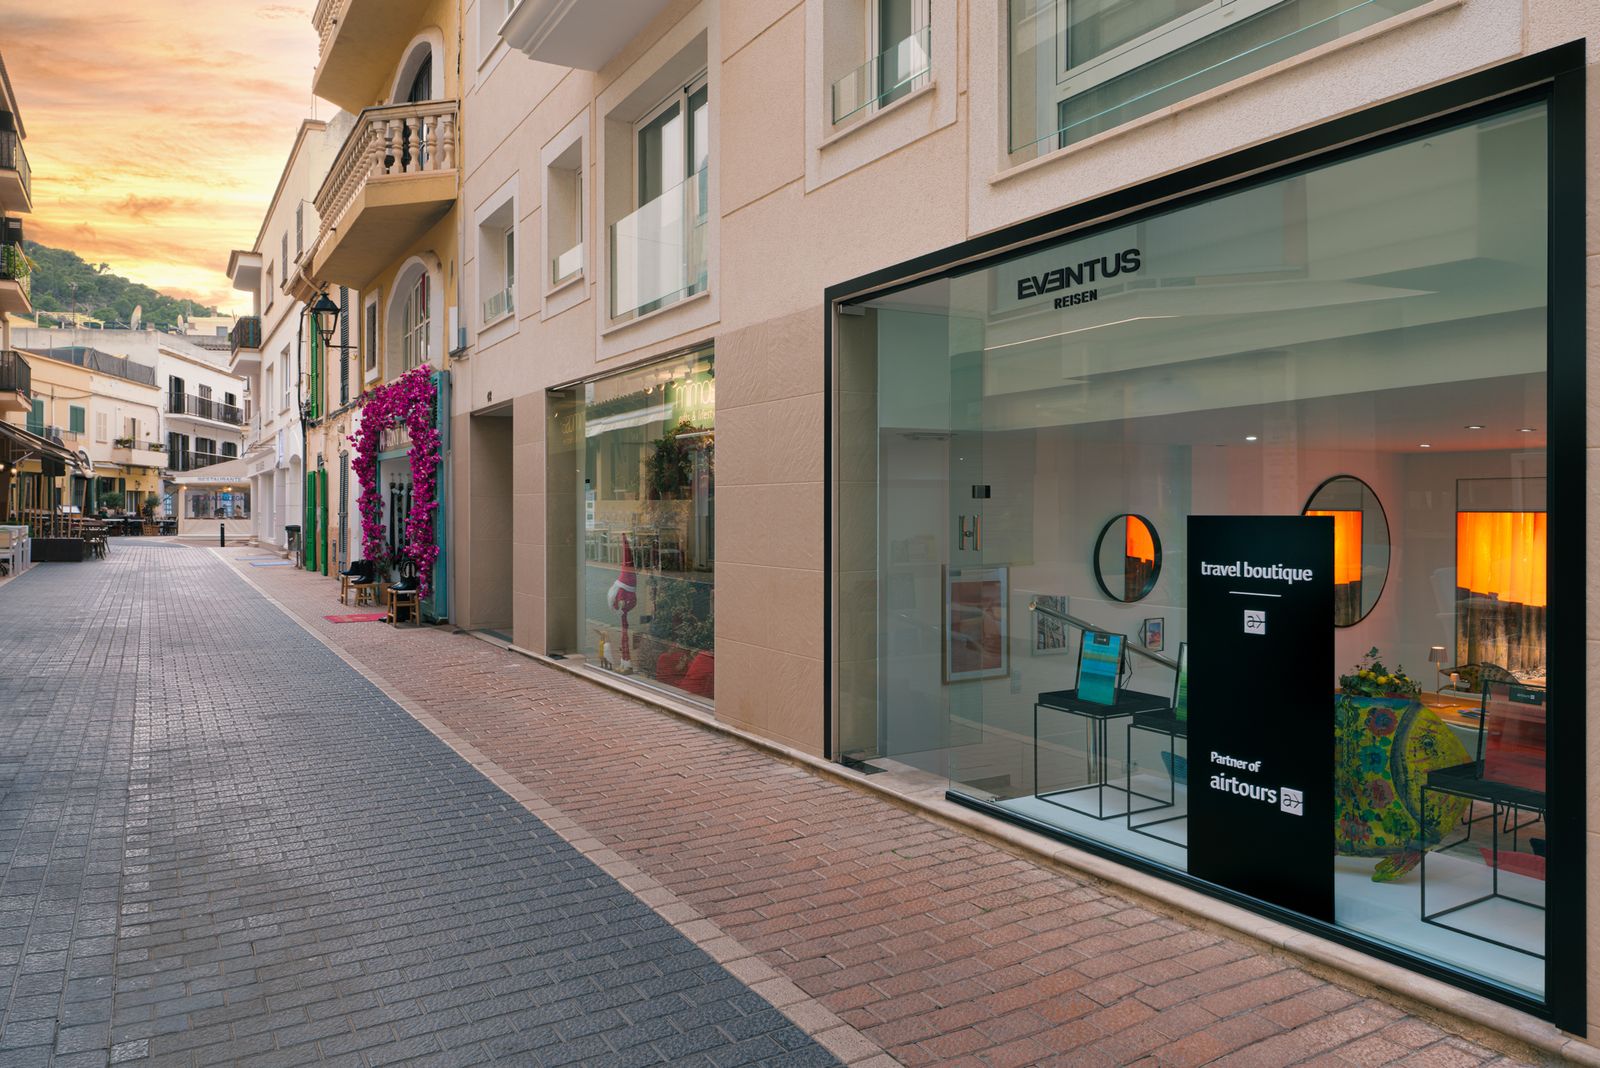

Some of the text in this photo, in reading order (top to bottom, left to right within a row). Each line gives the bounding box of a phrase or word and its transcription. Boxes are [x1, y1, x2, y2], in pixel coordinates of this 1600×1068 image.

[1018, 248, 1141, 300] EVENTUS
[1054, 289, 1098, 310] REISEN
[1201, 561, 1313, 585] travel boutique
[1210, 751, 1262, 773] Partner of
[1210, 772, 1277, 804] airtours
